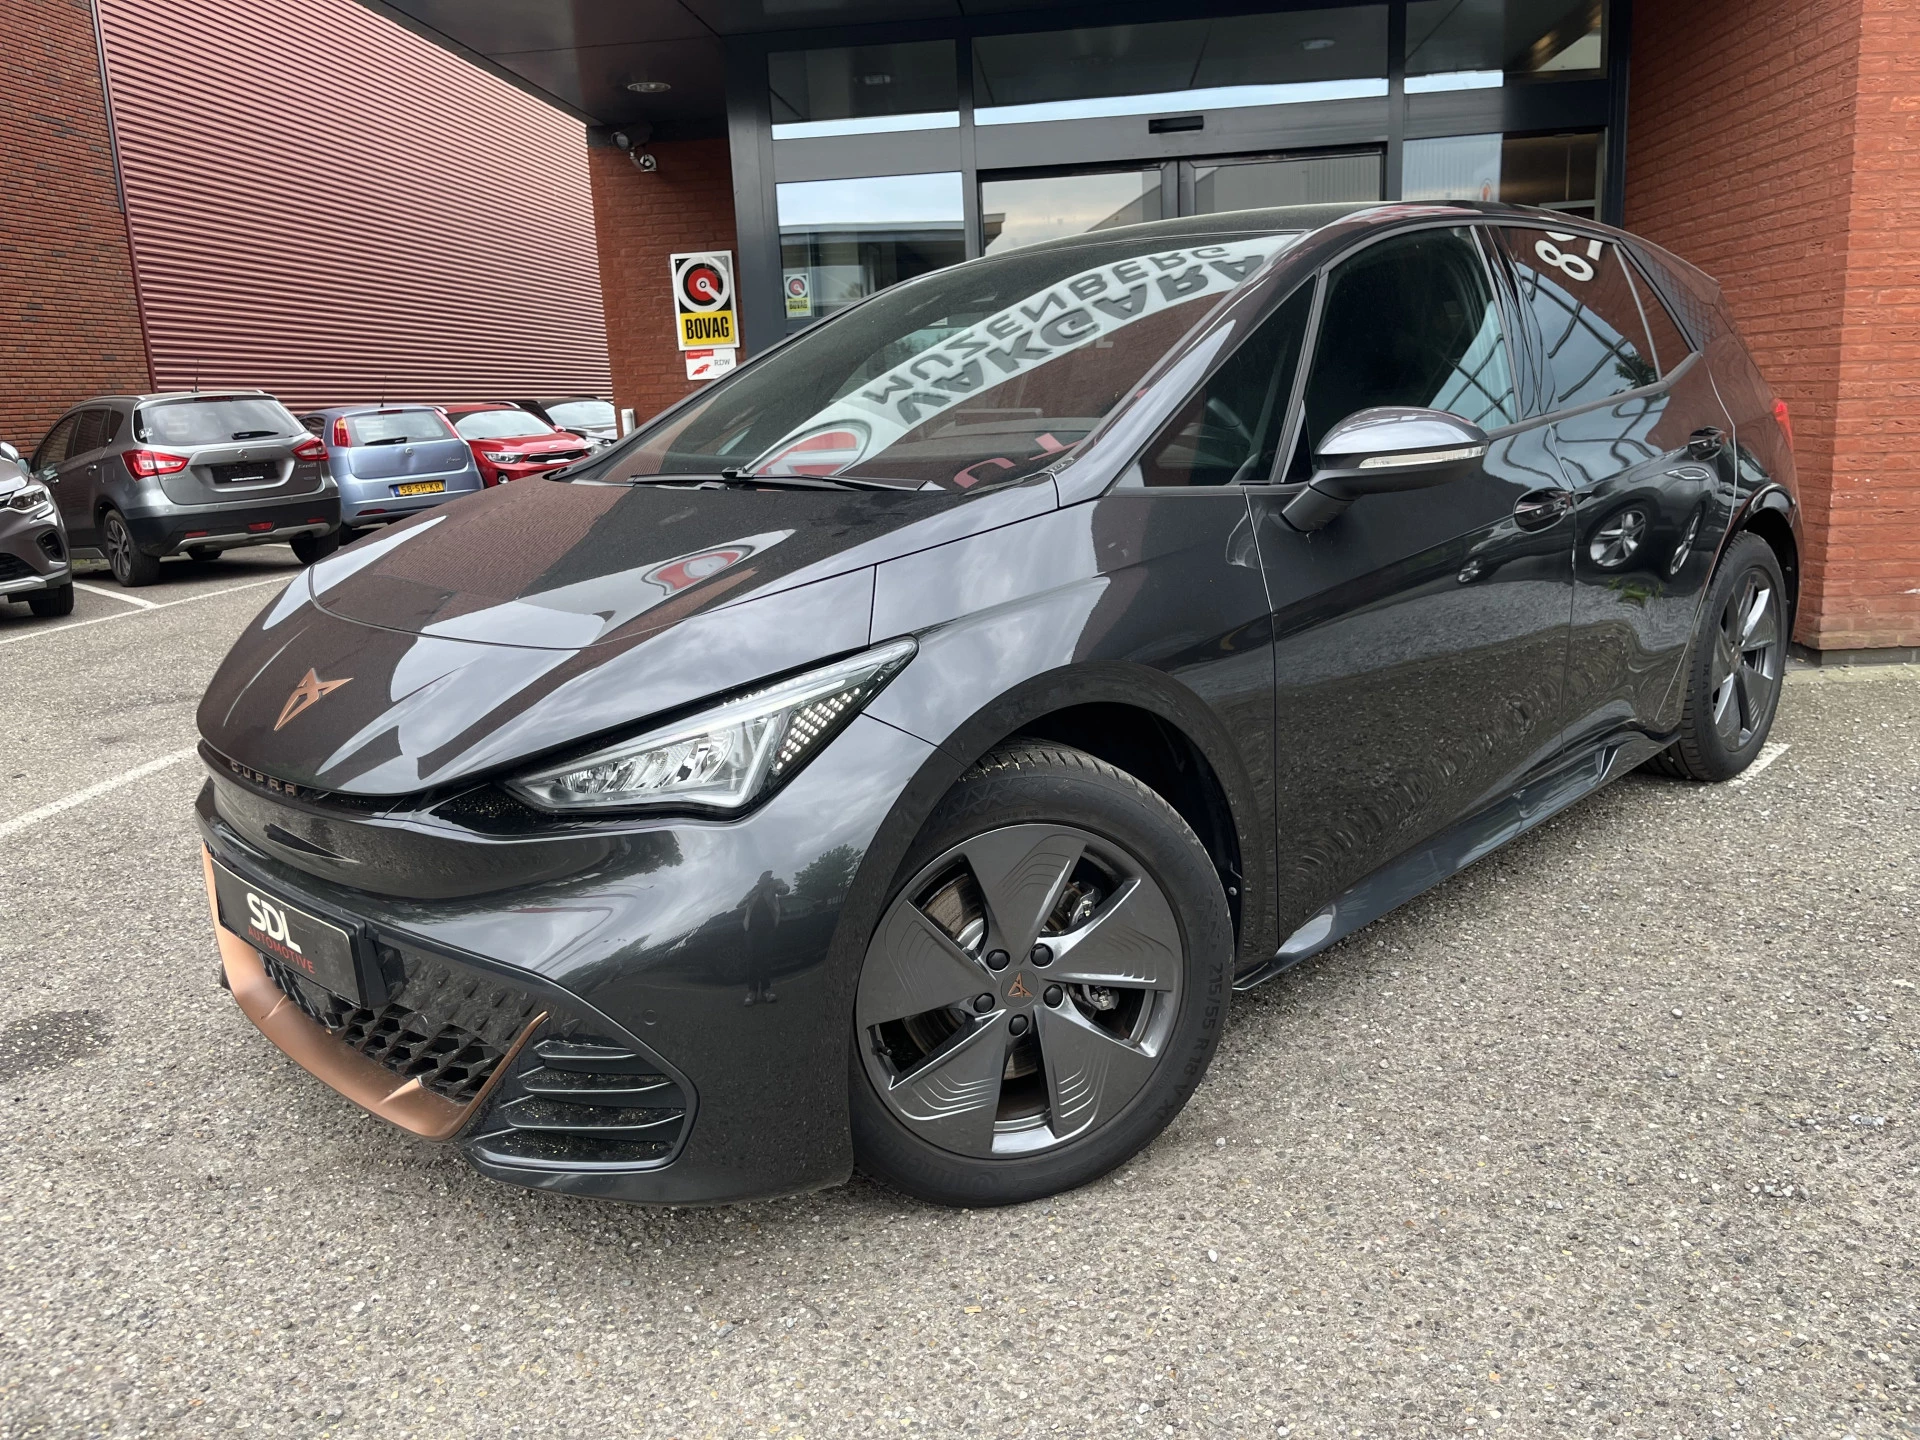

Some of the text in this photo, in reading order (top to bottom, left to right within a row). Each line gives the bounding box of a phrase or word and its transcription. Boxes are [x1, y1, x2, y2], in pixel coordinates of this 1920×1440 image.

[685, 316, 730, 340] BOVAG
[401, 482, 441, 494] 58-SH-KR
[231, 760, 297, 798] CUPRA
[246, 892, 303, 955] SDL
[248, 924, 316, 974] AUTOMOTIVE
[1202, 962, 1224, 1030] 215/55
[1183, 1056, 1201, 1076] 18
